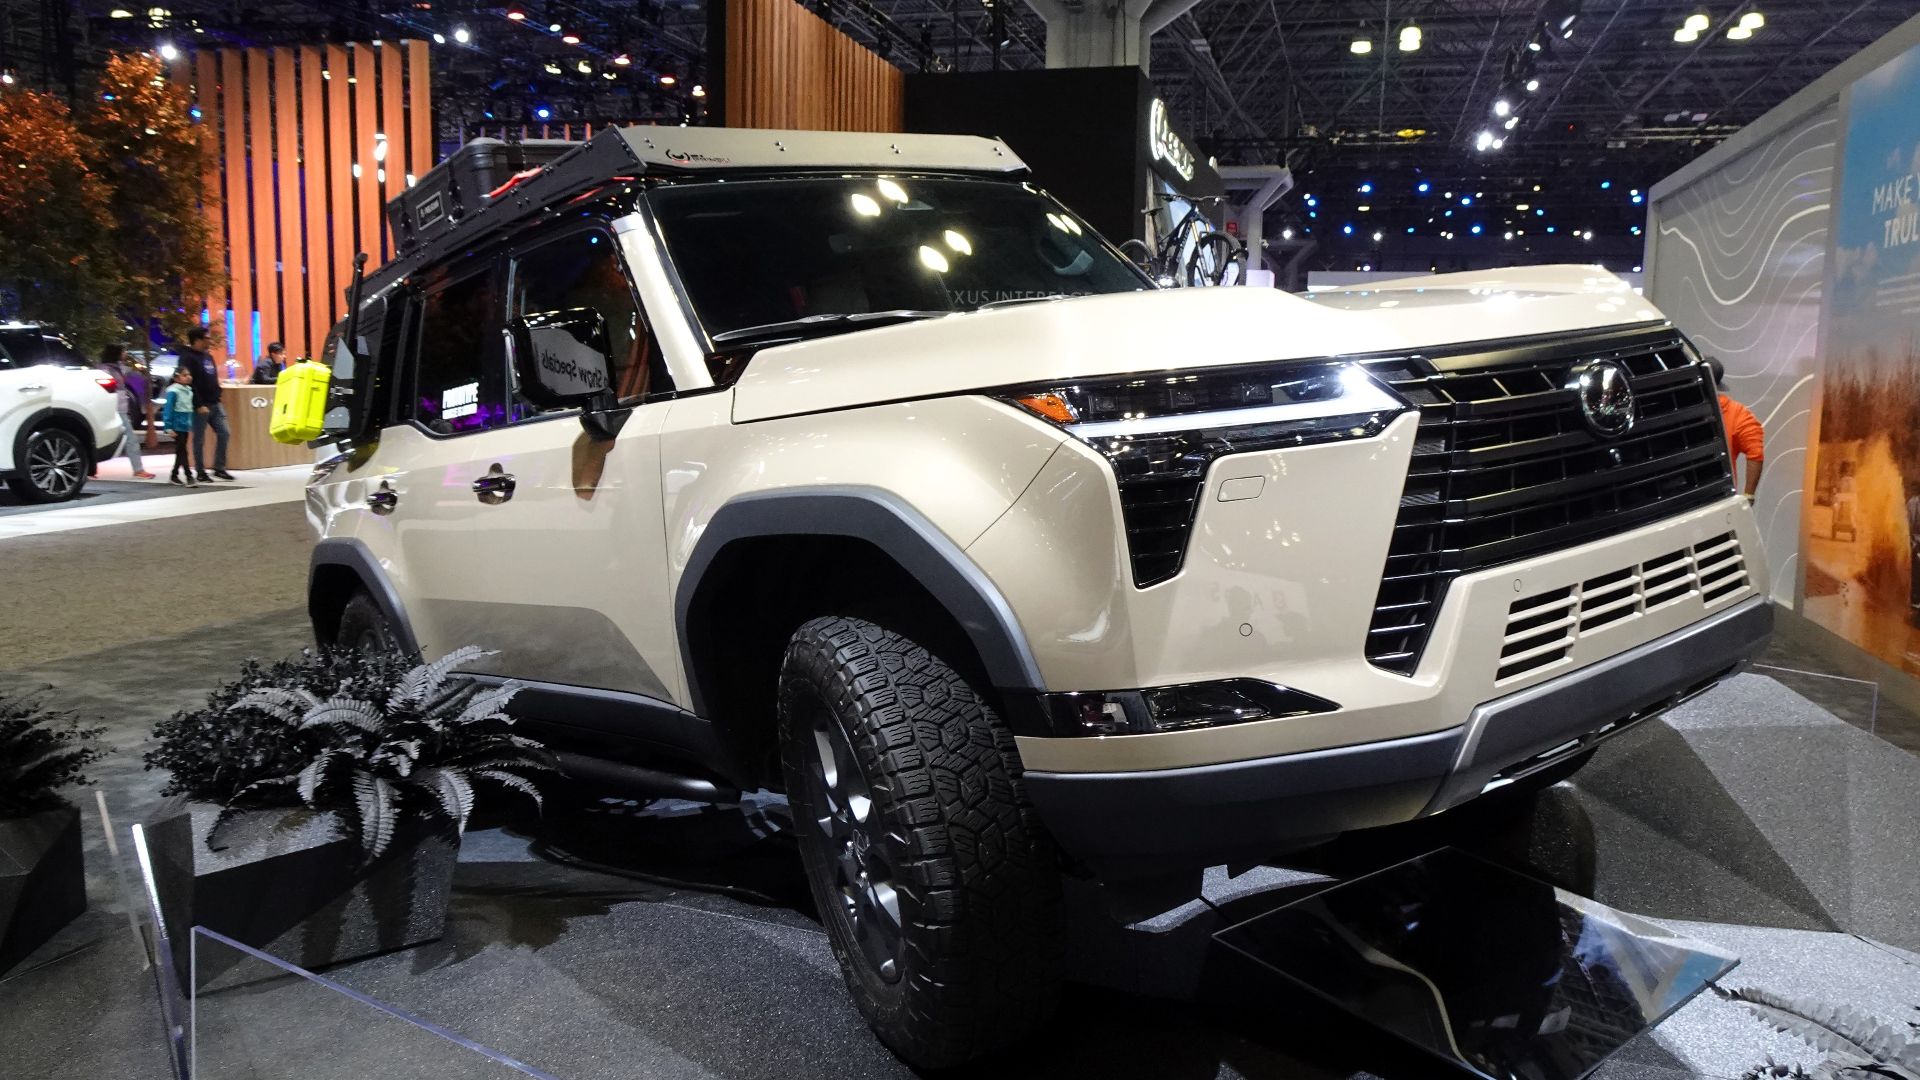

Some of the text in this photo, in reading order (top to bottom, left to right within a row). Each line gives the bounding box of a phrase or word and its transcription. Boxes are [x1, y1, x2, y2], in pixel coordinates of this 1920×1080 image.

[1872, 174, 1914, 215] MAKE
[947, 290, 1093, 304] XUS INTER
